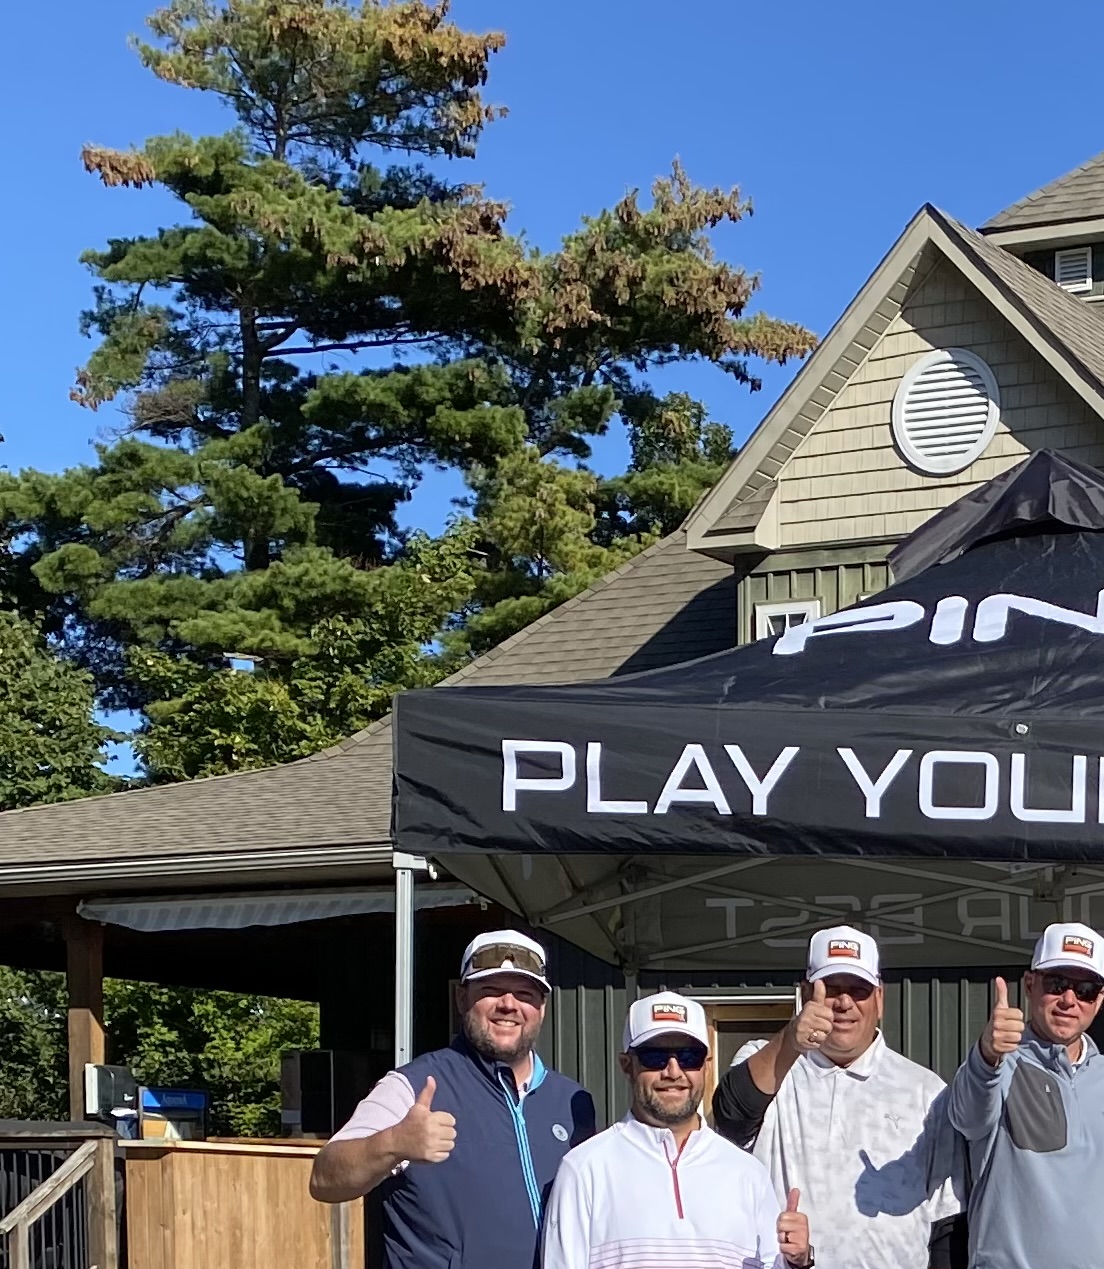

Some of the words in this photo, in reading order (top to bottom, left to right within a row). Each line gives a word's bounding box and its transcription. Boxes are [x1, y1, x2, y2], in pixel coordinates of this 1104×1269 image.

[501, 739, 800, 817] PLAY
[830, 940, 859, 950] PING
[1065, 936, 1093, 949] PING
[653, 1003, 685, 1014] PING
